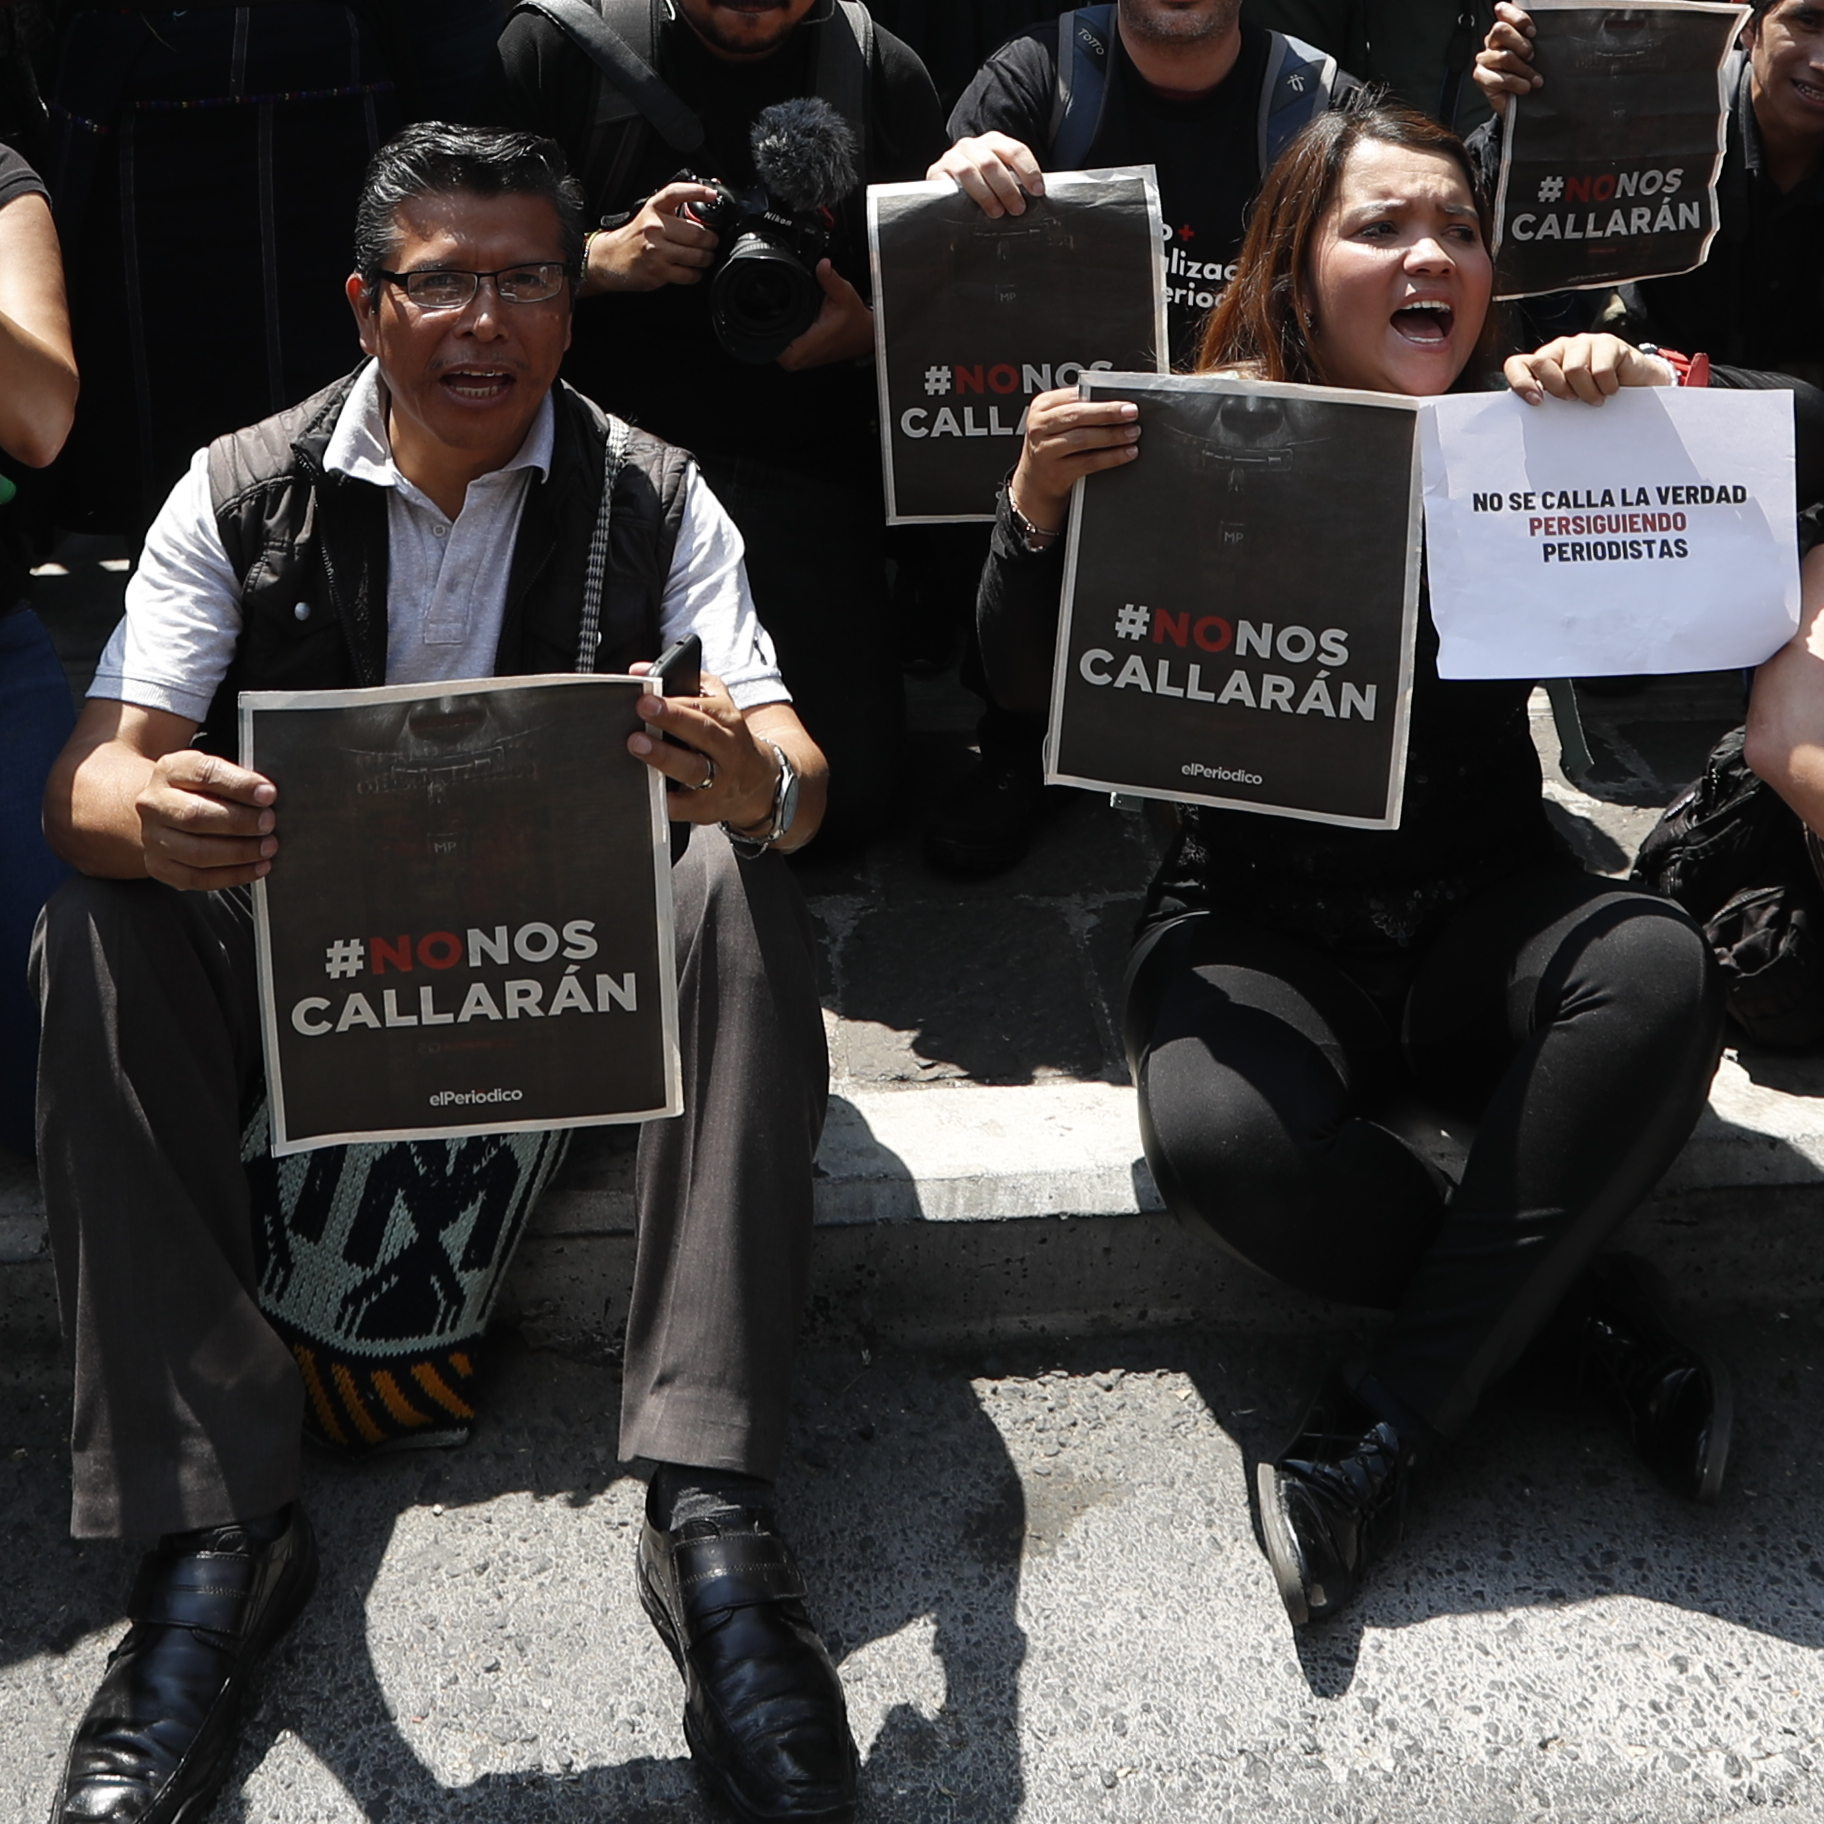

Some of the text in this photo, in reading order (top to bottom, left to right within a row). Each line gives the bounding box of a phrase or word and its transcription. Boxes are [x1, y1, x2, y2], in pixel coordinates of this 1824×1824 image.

[1078, 28, 1105, 56] TOTTO
[1538, 168, 1683, 203] #NONOS
[764, 211, 793, 226] Nikon
[1511, 197, 1701, 241] CALLARÁN
[1472, 485, 1747, 510] NO SE CALLA LA VERDAD
[1224, 531, 1244, 542] MP
[1529, 514, 1687, 535] PERSIGUIENDO
[1542, 540, 1689, 562] PERIODISTAS
[1115, 604, 1349, 668] #NONOS
[1079, 648, 1376, 721] CALLARÁN
[1181, 762, 1263, 785] elPeriodico
[325, 920, 598, 979] #NONOS
[291, 965, 638, 1036] CALLARÁN
[429, 1088, 523, 1107] elPeriodico
